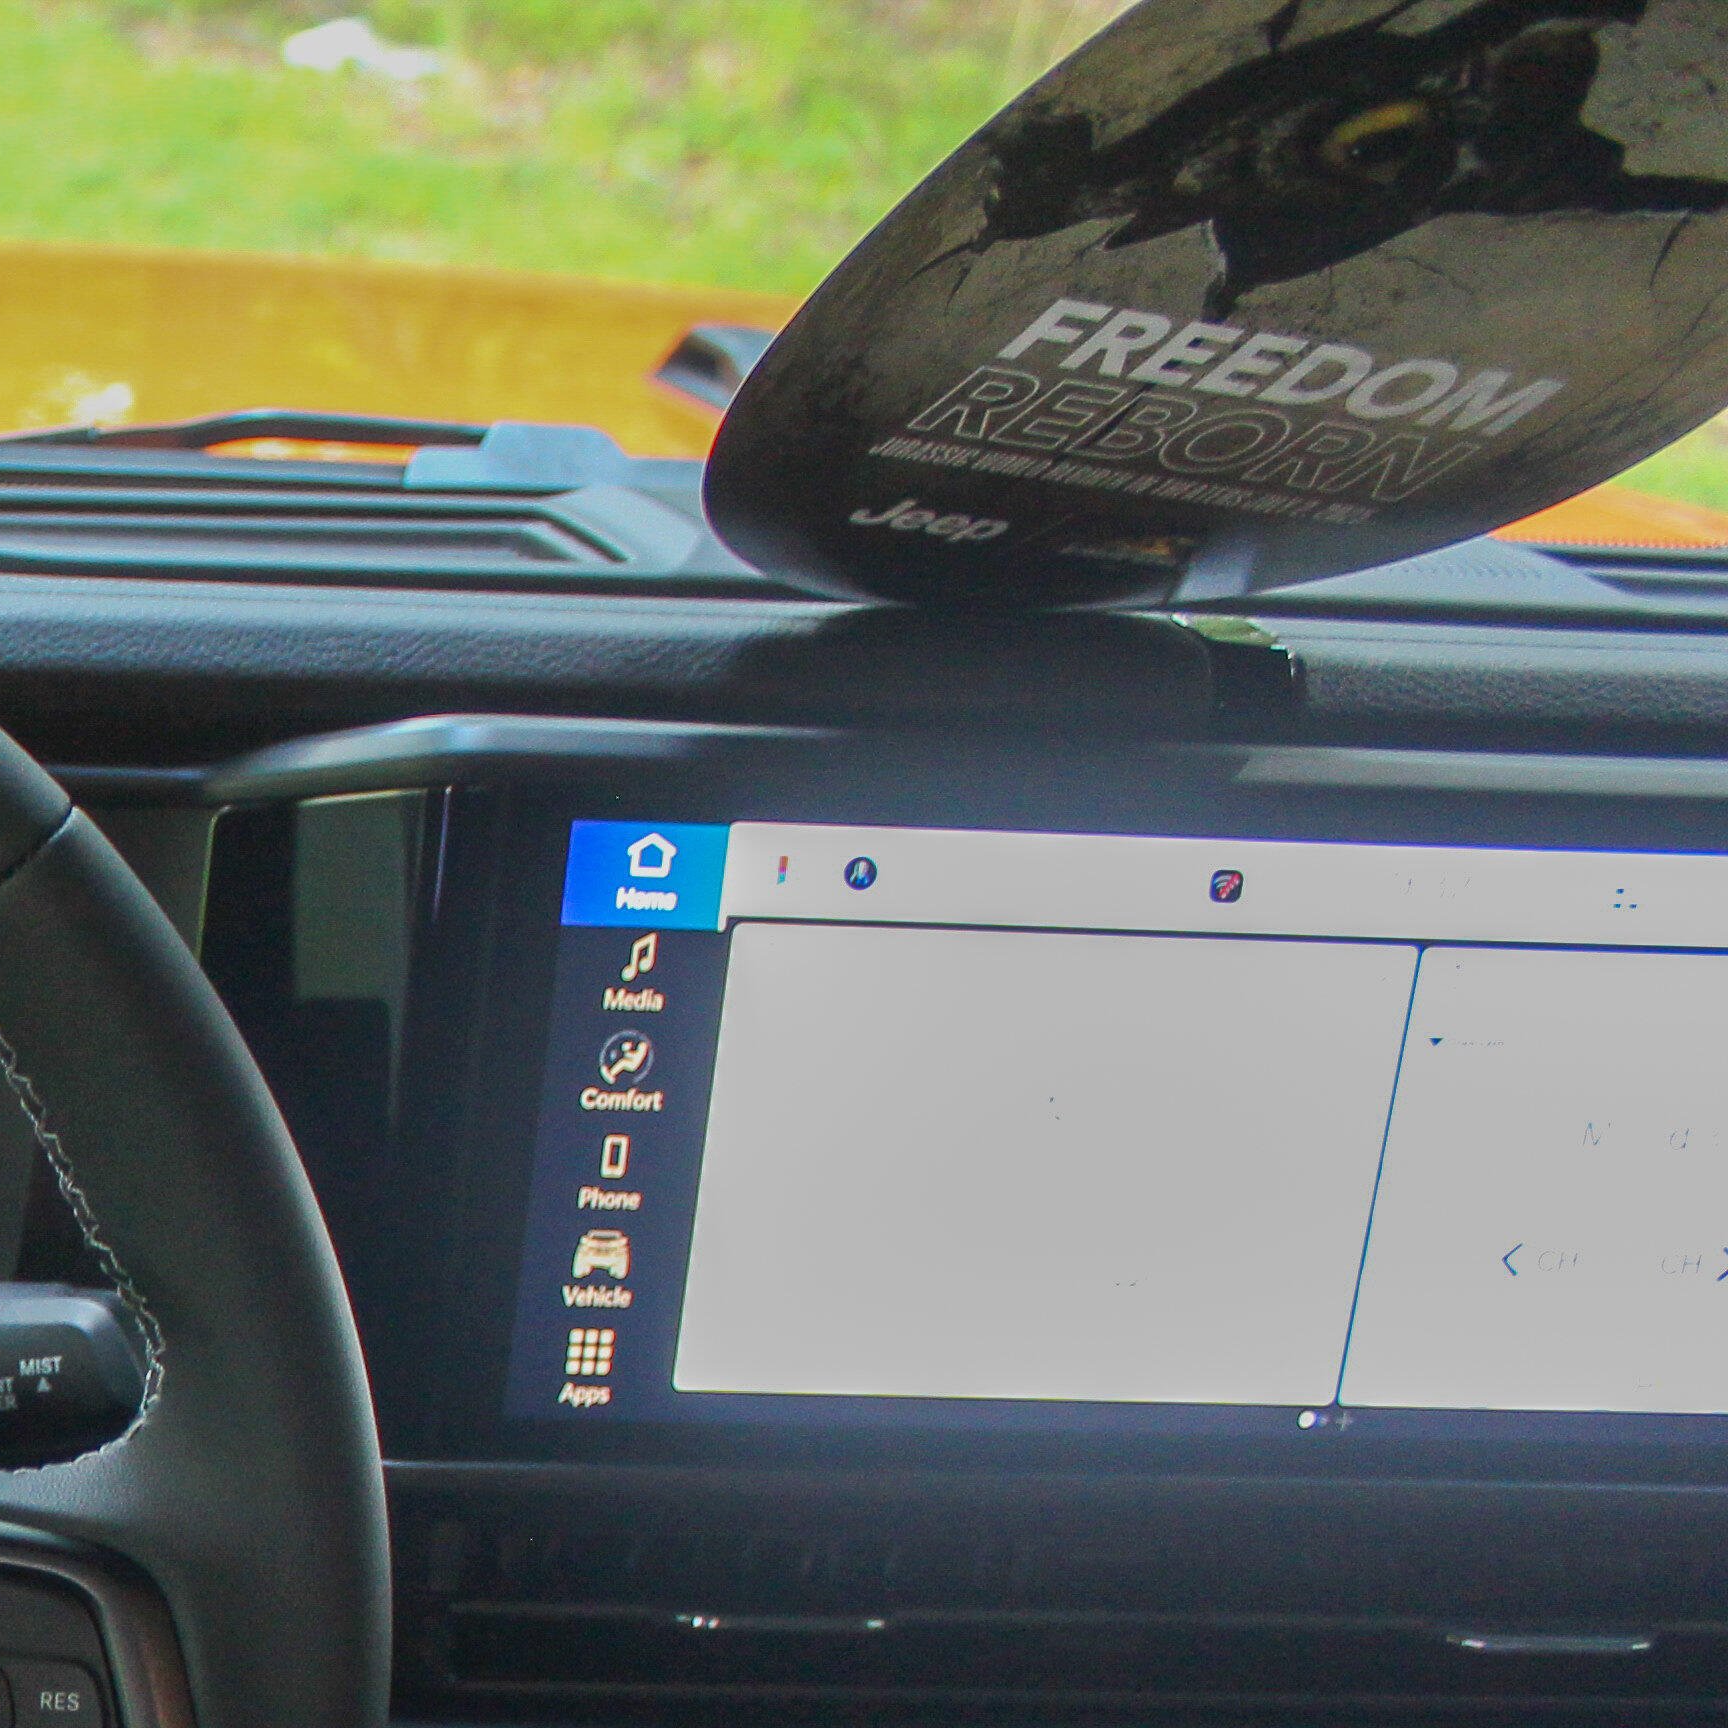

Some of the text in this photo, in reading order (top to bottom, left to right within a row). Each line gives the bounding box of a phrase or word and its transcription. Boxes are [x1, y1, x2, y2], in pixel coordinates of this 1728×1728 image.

[997, 298, 1566, 436] FREEDOM
[908, 364, 1482, 501] REBORN
[849, 499, 1009, 543] Jeep
[615, 886, 677, 911] Home
[602, 987, 665, 1012] Media
[580, 1087, 664, 1112] Comfort
[577, 1187, 642, 1211] Phone
[562, 1284, 633, 1309] Vehicle
[19, 1355, 63, 1377] MIST
[557, 1382, 612, 1407] Apps
[39, 1691, 81, 1712] RES
